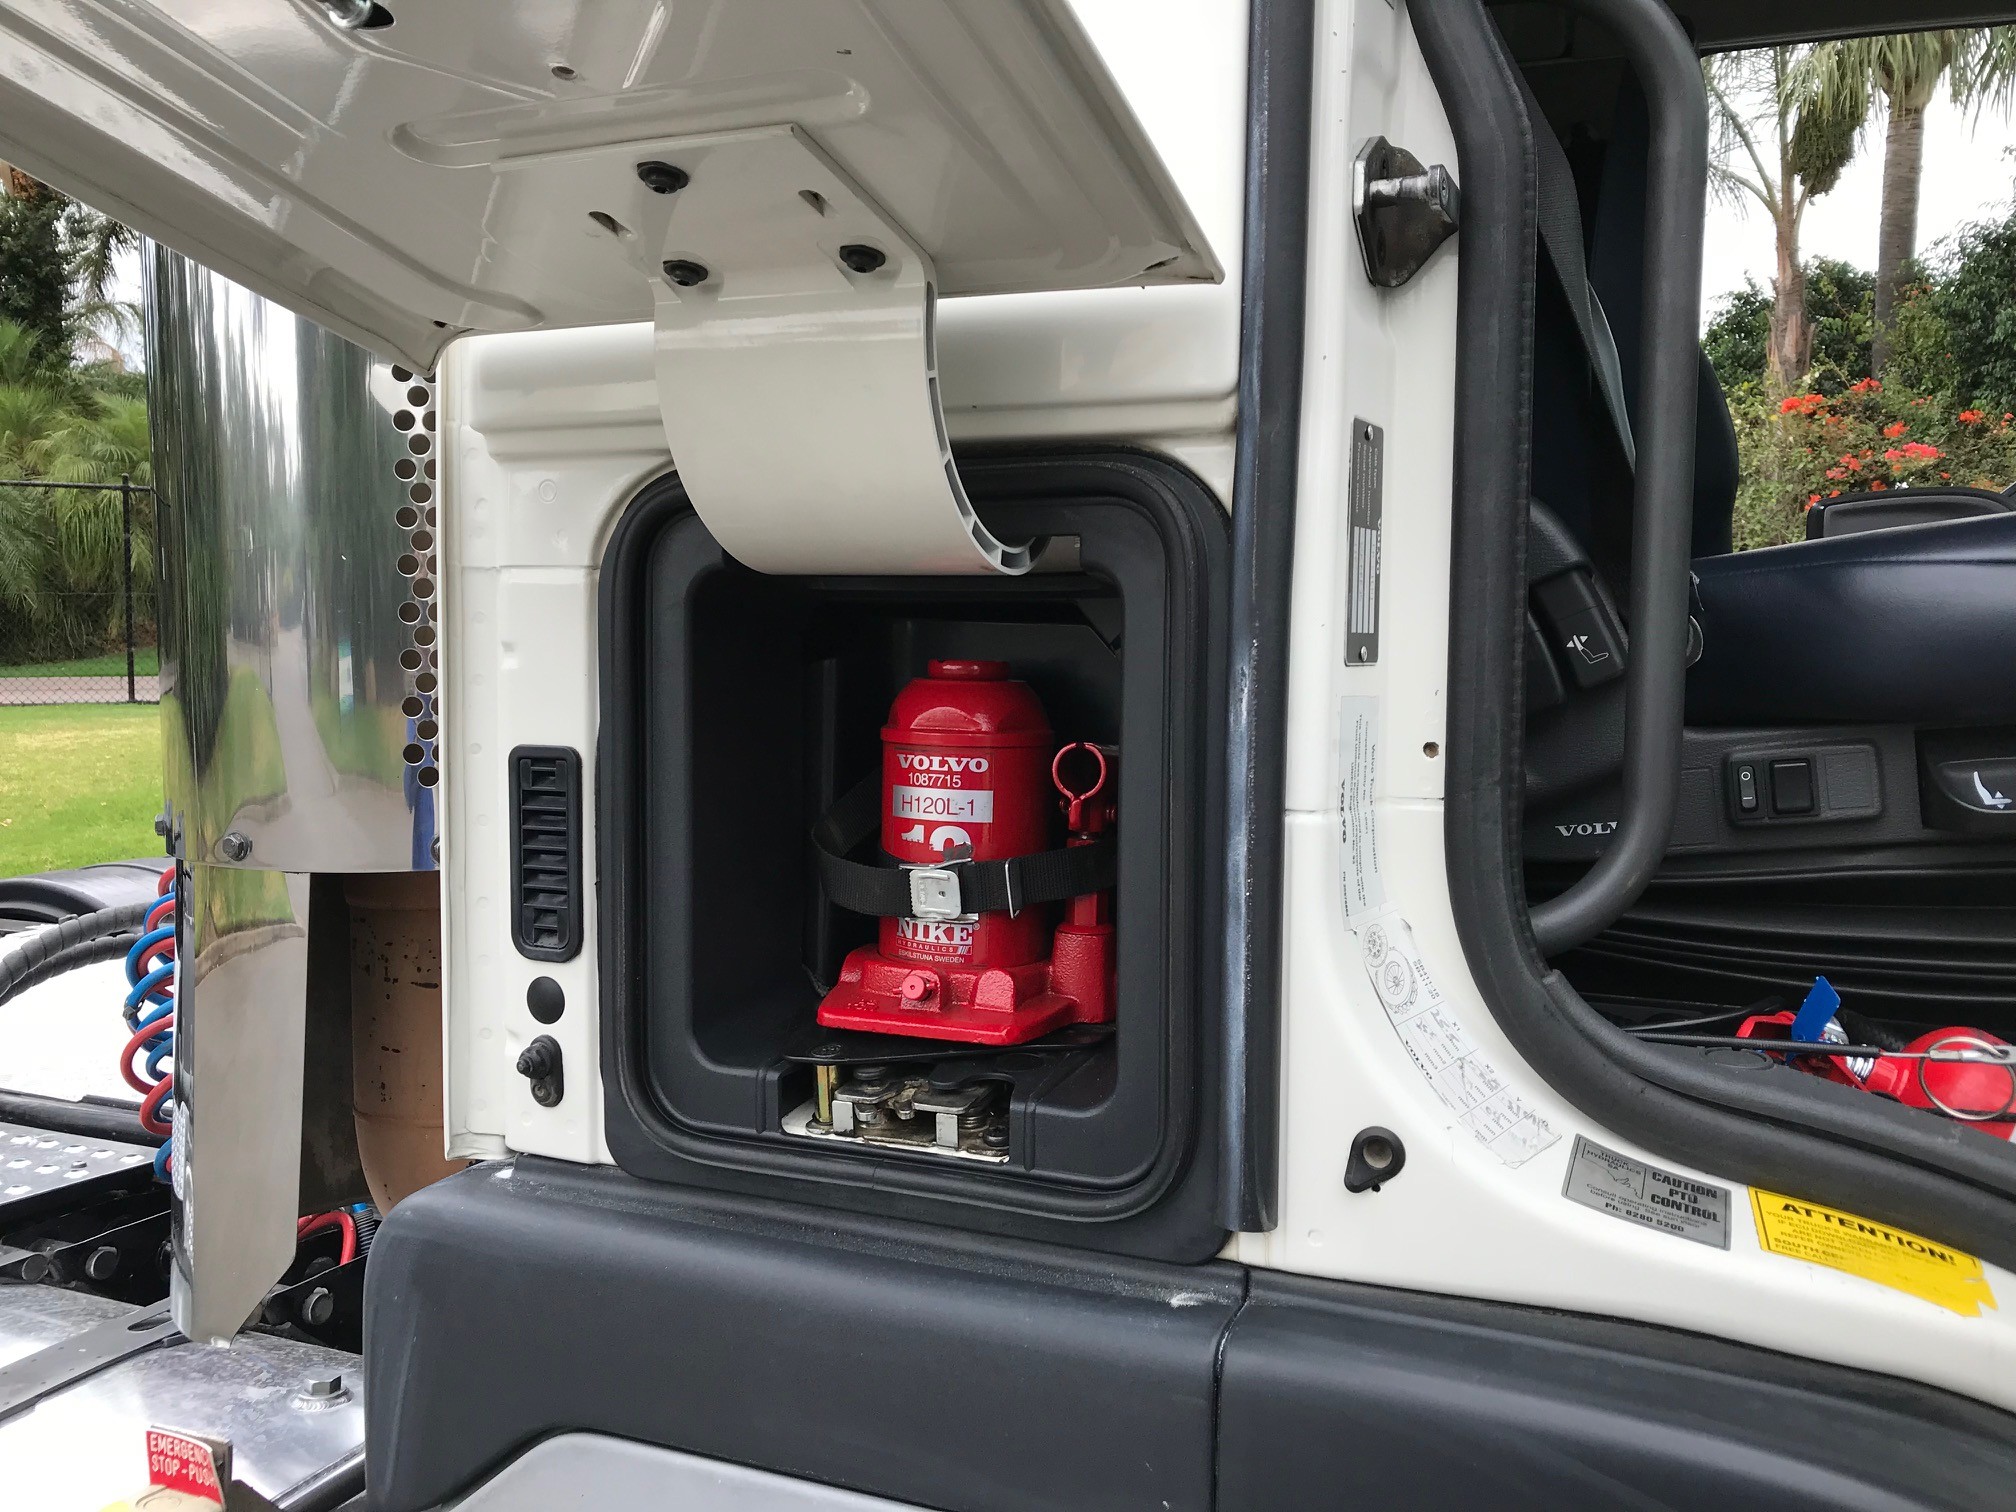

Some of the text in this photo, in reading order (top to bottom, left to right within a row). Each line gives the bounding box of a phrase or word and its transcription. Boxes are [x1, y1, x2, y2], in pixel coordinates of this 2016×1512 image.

[896, 754, 989, 773] VOLVO
[908, 772, 961, 788] 1087715
[901, 794, 974, 816] H120L-1
[896, 917, 973, 945] NIKE
[897, 940, 954, 953] HYDRAULICS
[898, 949, 965, 963] ESKILSTUNA SWEDEN
[1452, 1021, 1461, 1031] X1
[1405, 1039, 1433, 1080] VOLVO
[1485, 1063, 1495, 1074] X2
[1586, 1150, 1642, 1176] HYDRAULICS
[1600, 1151, 1629, 1166] TRUCK
[1651, 1170, 1718, 1199] CAUTION
[1586, 1183, 1617, 1198] Consult
[1618, 1194, 1658, 1212] operating
[1590, 1189, 1616, 1202] before
[1668, 1188, 1698, 1204] PTO
[1604, 1202, 1622, 1213] Ph:
[1650, 1193, 1721, 1223] CONTROL
[1765, 1209, 1794, 1222] YOUR
[1779, 1229, 1814, 1244] REFER
[1781, 1202, 1957, 1266] ATTENTION!
[1791, 1227, 1812, 1238] ARE
[1773, 1235, 1819, 1254] SOUTH
[1774, 1242, 1802, 1255] FREE
[150, 1434, 211, 1466] EMERGENC
